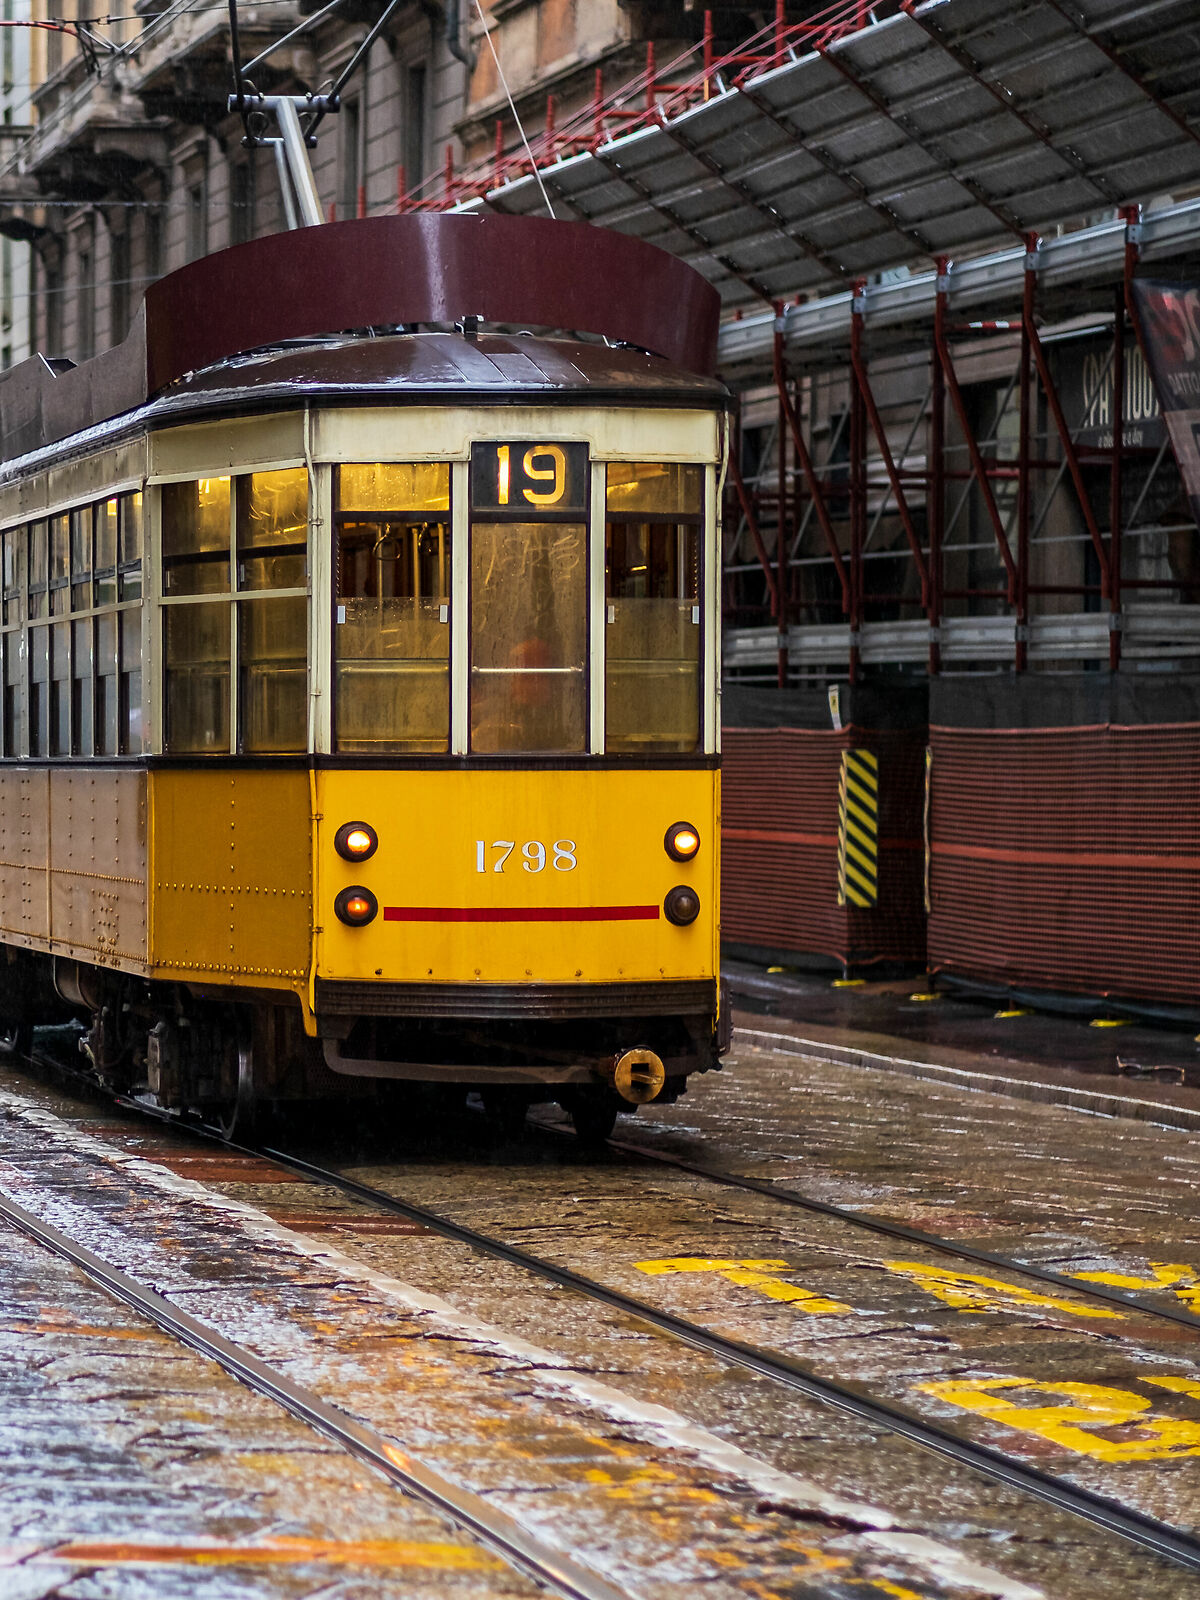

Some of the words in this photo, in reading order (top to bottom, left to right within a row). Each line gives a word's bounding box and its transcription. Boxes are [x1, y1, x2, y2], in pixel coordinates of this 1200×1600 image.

[497, 445, 566, 505] 19
[475, 839, 578, 873] 1798
[909, 1376, 1200, 1463] B
